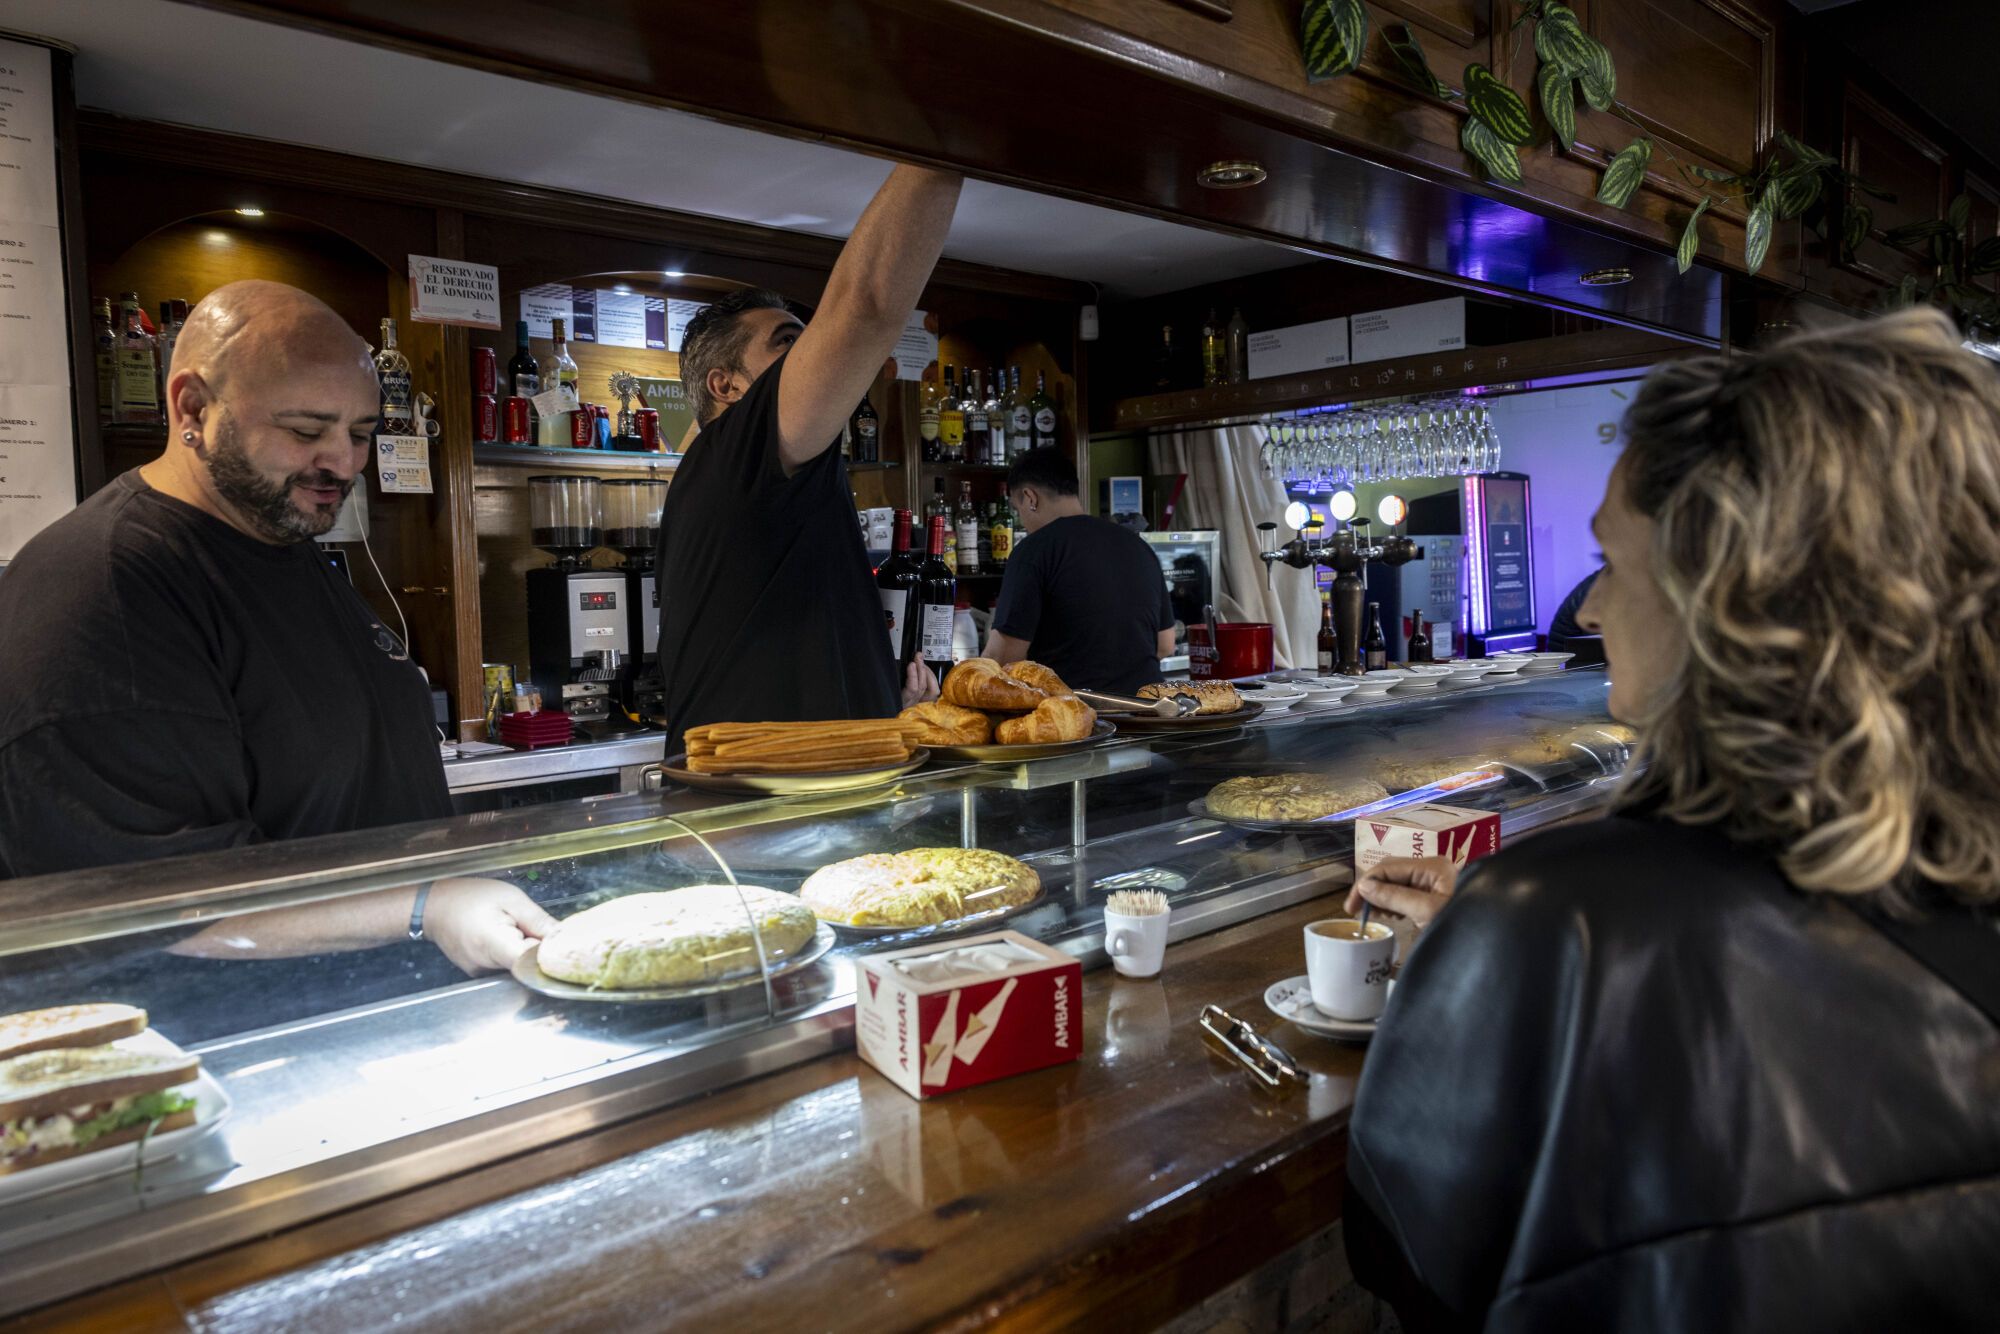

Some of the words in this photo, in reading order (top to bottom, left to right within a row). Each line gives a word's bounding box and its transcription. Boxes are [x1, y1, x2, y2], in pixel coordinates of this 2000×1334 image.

[432, 264, 495, 281] RESERVADO
[426, 274, 440, 284] EL
[442, 276, 493, 292] DERECHO
[424, 285, 438, 295] DE
[440, 286, 495, 302] ADMISIÓN
[1463, 359, 1474, 373] 16
[1497, 356, 1508, 369] 17
[1350, 376, 1360, 388] 12
[1405, 369, 1415, 380] 14
[647, 384, 684, 398] AMB
[663, 402, 686, 411] 1900
[1412, 831, 1424, 860] BAR
[1055, 986, 1069, 1049] AMBAR
[898, 991, 908, 1072] AMBAR
